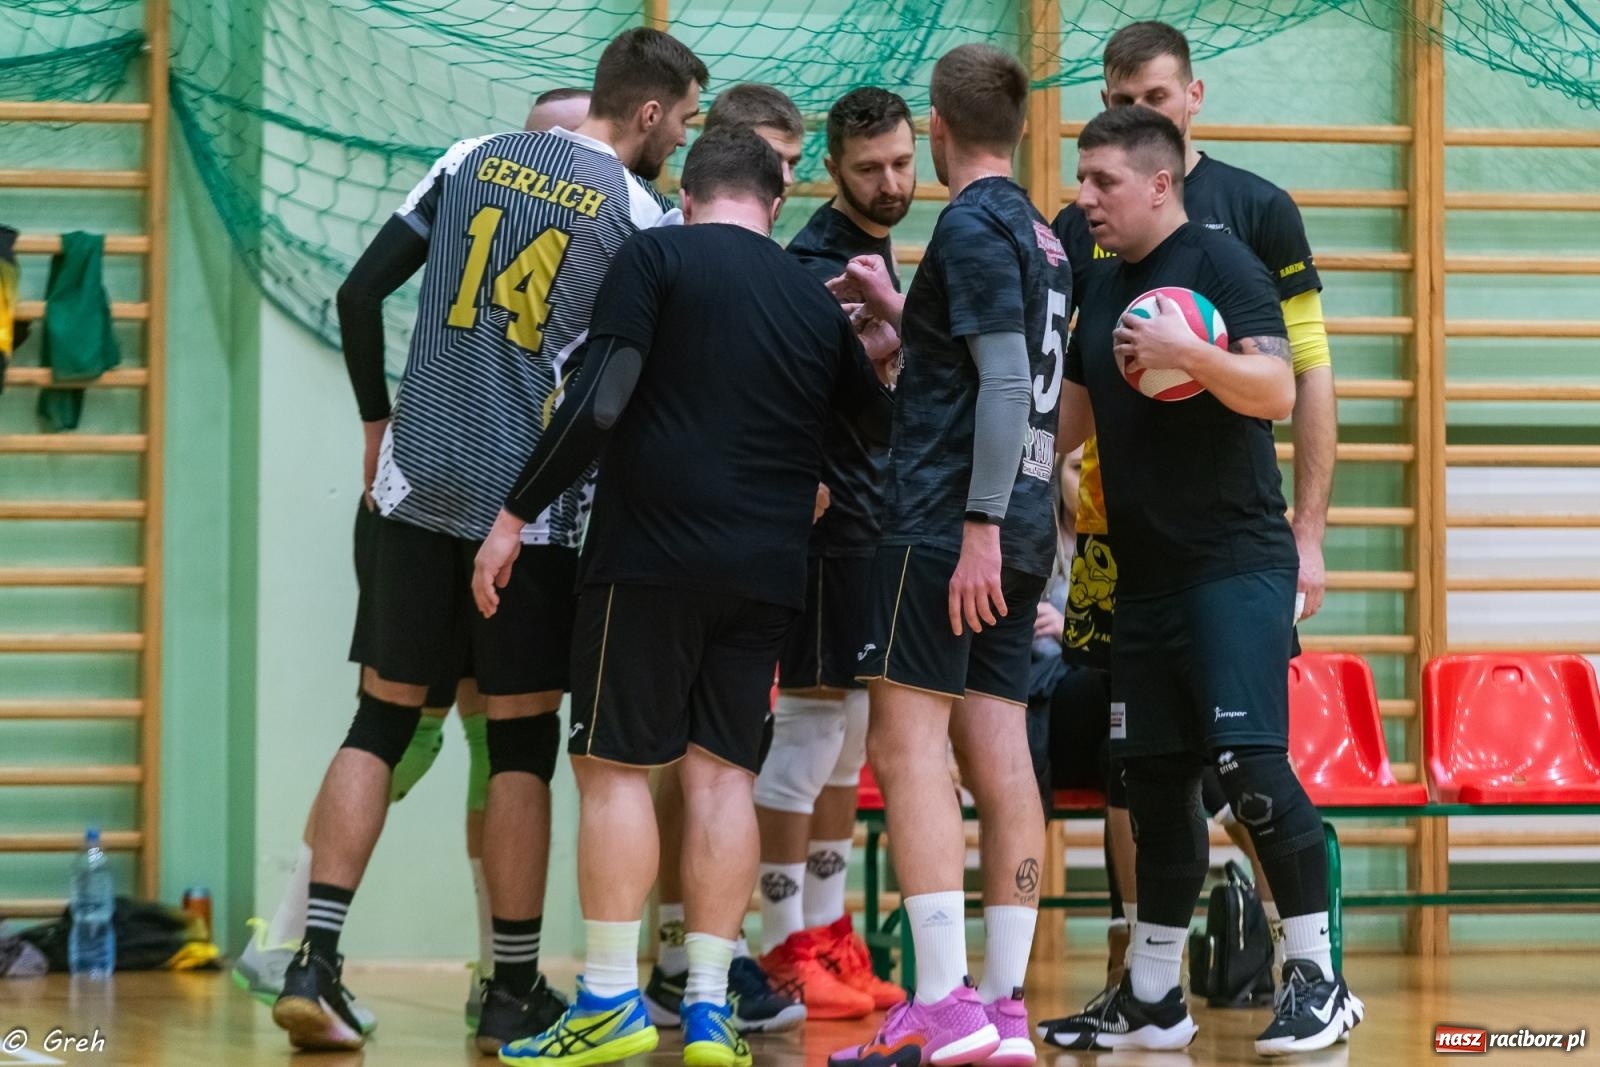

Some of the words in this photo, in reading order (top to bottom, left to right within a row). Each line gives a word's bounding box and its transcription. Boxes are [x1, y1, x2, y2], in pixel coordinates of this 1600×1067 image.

[477, 157, 607, 218] GERLICH
[447, 206, 570, 353] 14
[1033, 288, 1066, 413] 5
